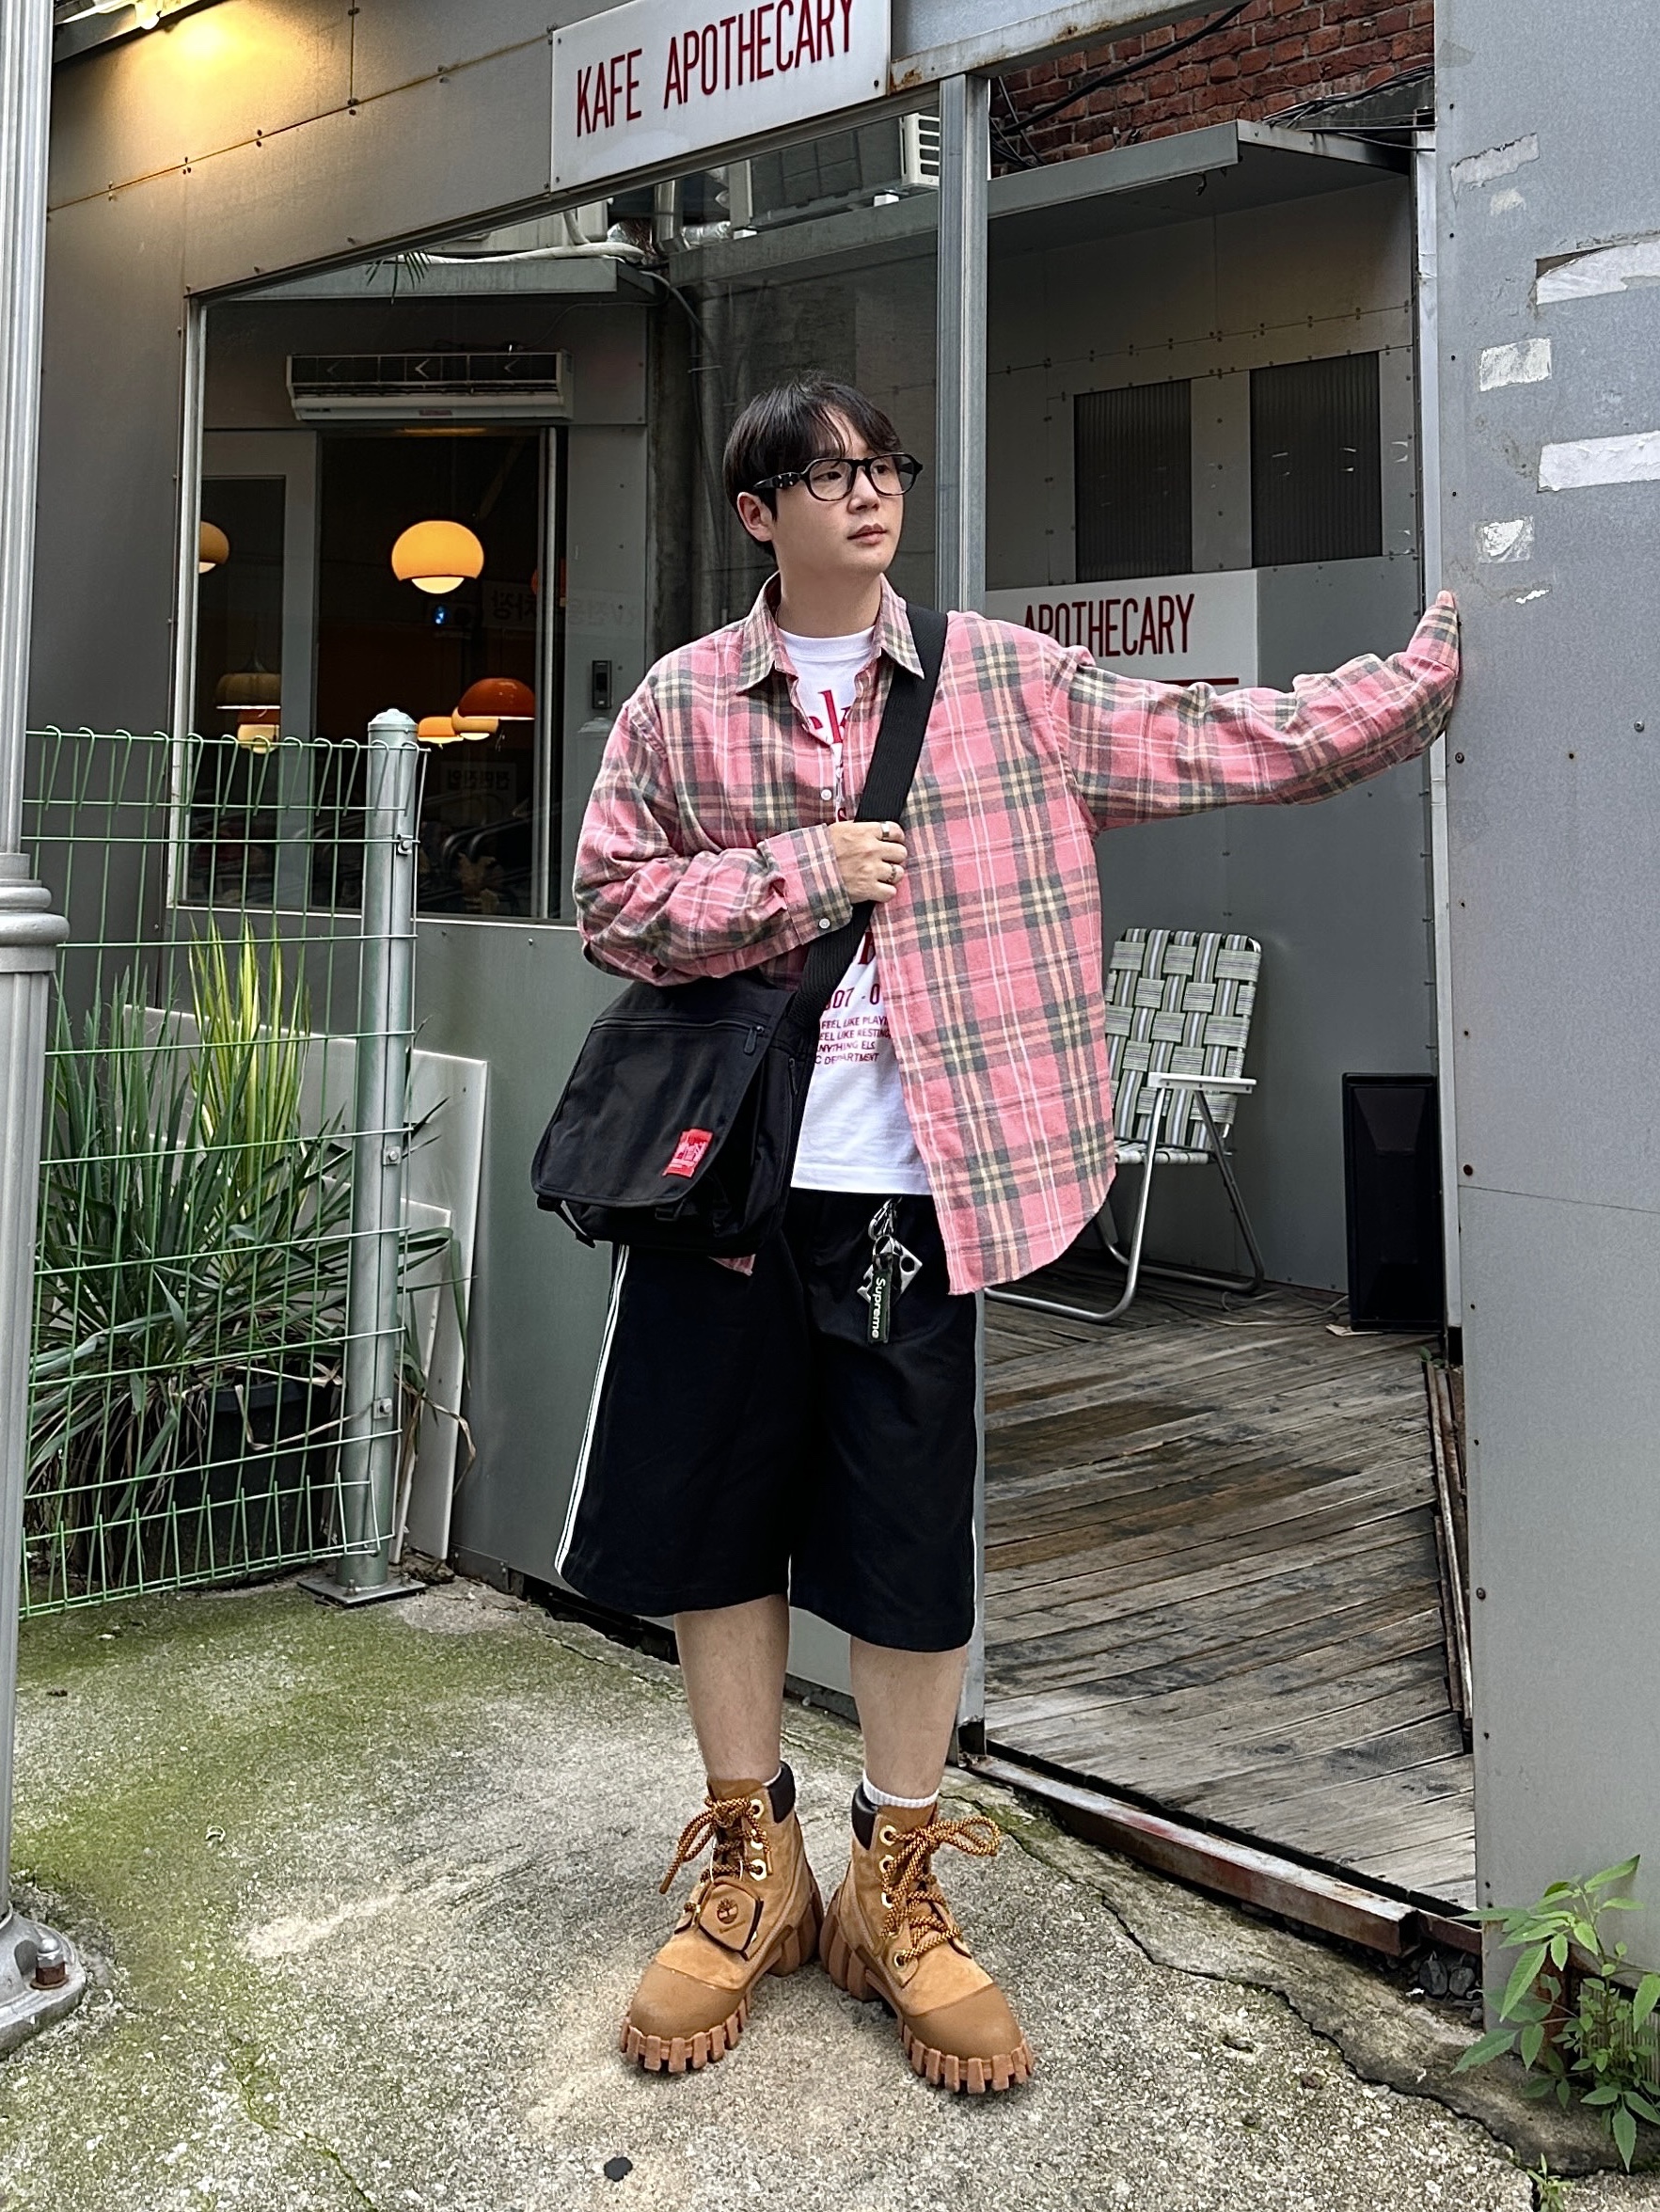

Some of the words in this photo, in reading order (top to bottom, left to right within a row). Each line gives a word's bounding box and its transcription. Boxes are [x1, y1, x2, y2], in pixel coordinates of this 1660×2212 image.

[577, 48, 642, 137] KAFE
[663, 0, 853, 110] APOTHECARY
[1024, 593, 1194, 657] APOTHECARY
[819, 1032, 835, 1040] EEL
[837, 1030, 854, 1040] LIKE
[843, 1017, 860, 1028] LIKE
[817, 1041, 858, 1052] NYTHING
[872, 1277, 886, 1339] Supreme
